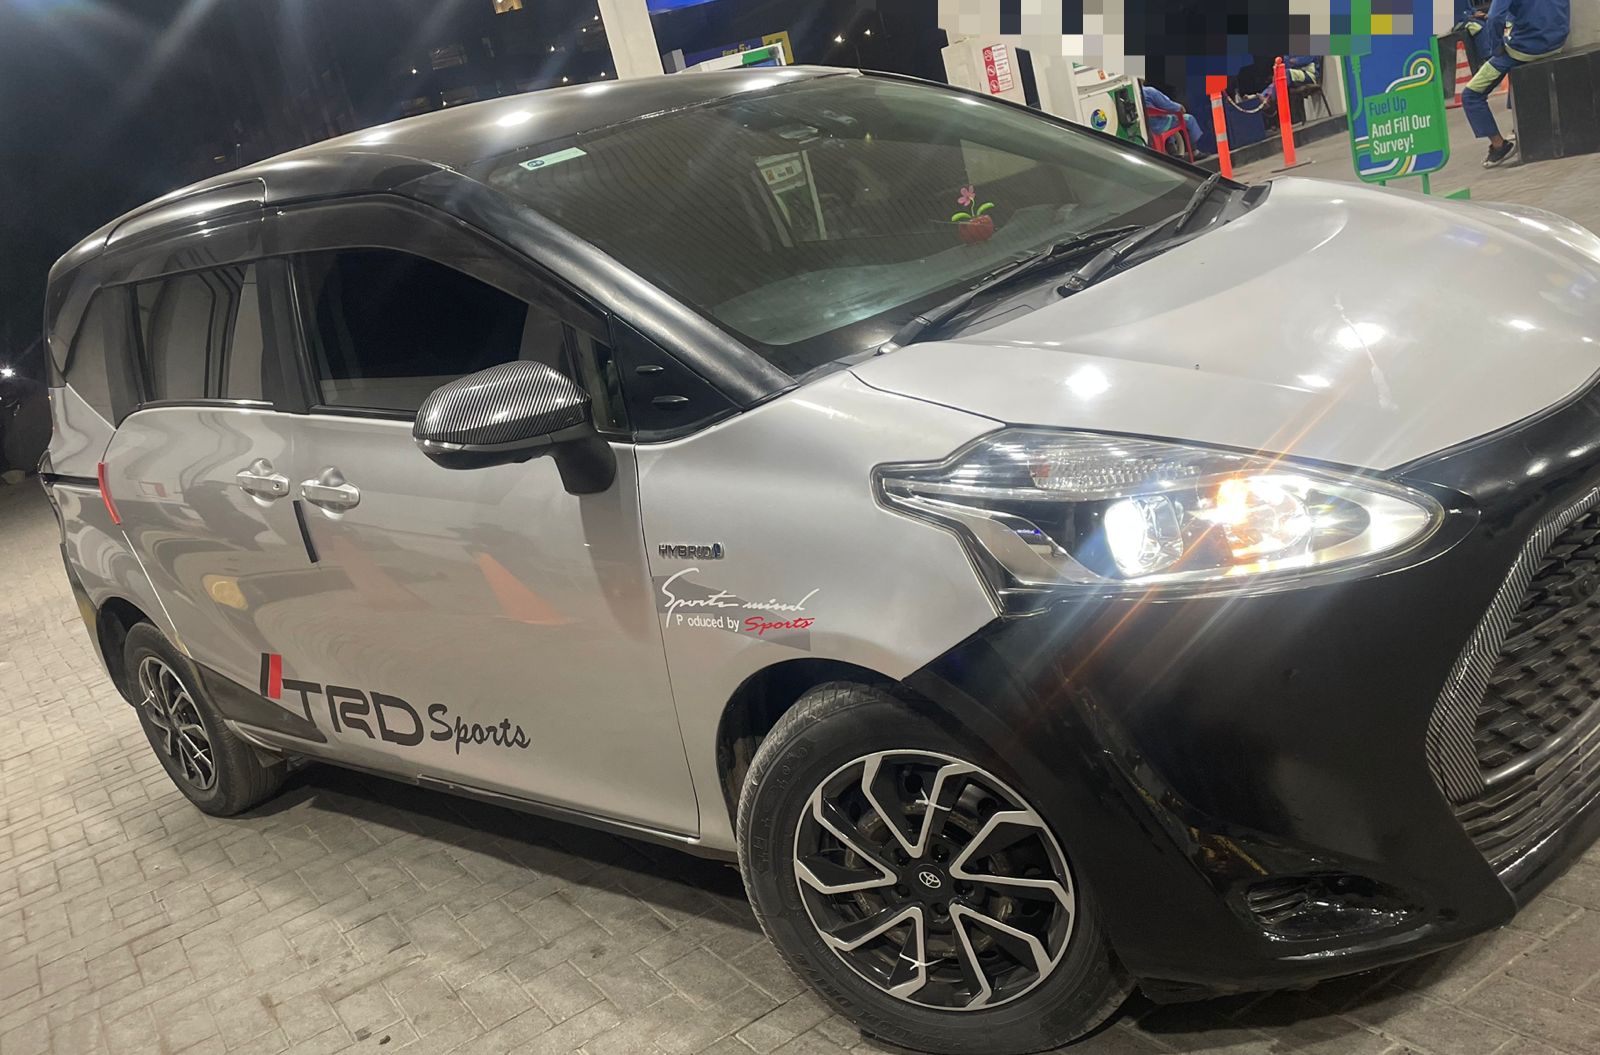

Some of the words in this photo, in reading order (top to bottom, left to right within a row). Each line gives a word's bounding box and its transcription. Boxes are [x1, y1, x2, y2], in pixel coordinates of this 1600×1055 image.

[1369, 99, 1391, 116] Fuel
[1393, 96, 1407, 114] Up
[1372, 120, 1392, 139] And
[1394, 115, 1410, 133] Fill
[1412, 114, 1431, 130] Our
[1373, 133, 1414, 155] Survey!
[658, 543, 712, 559] HYBRID
[727, 616, 740, 632] by
[744, 616, 815, 635] Sports
[281, 678, 425, 747] TRD
[427, 703, 531, 755] Sports
